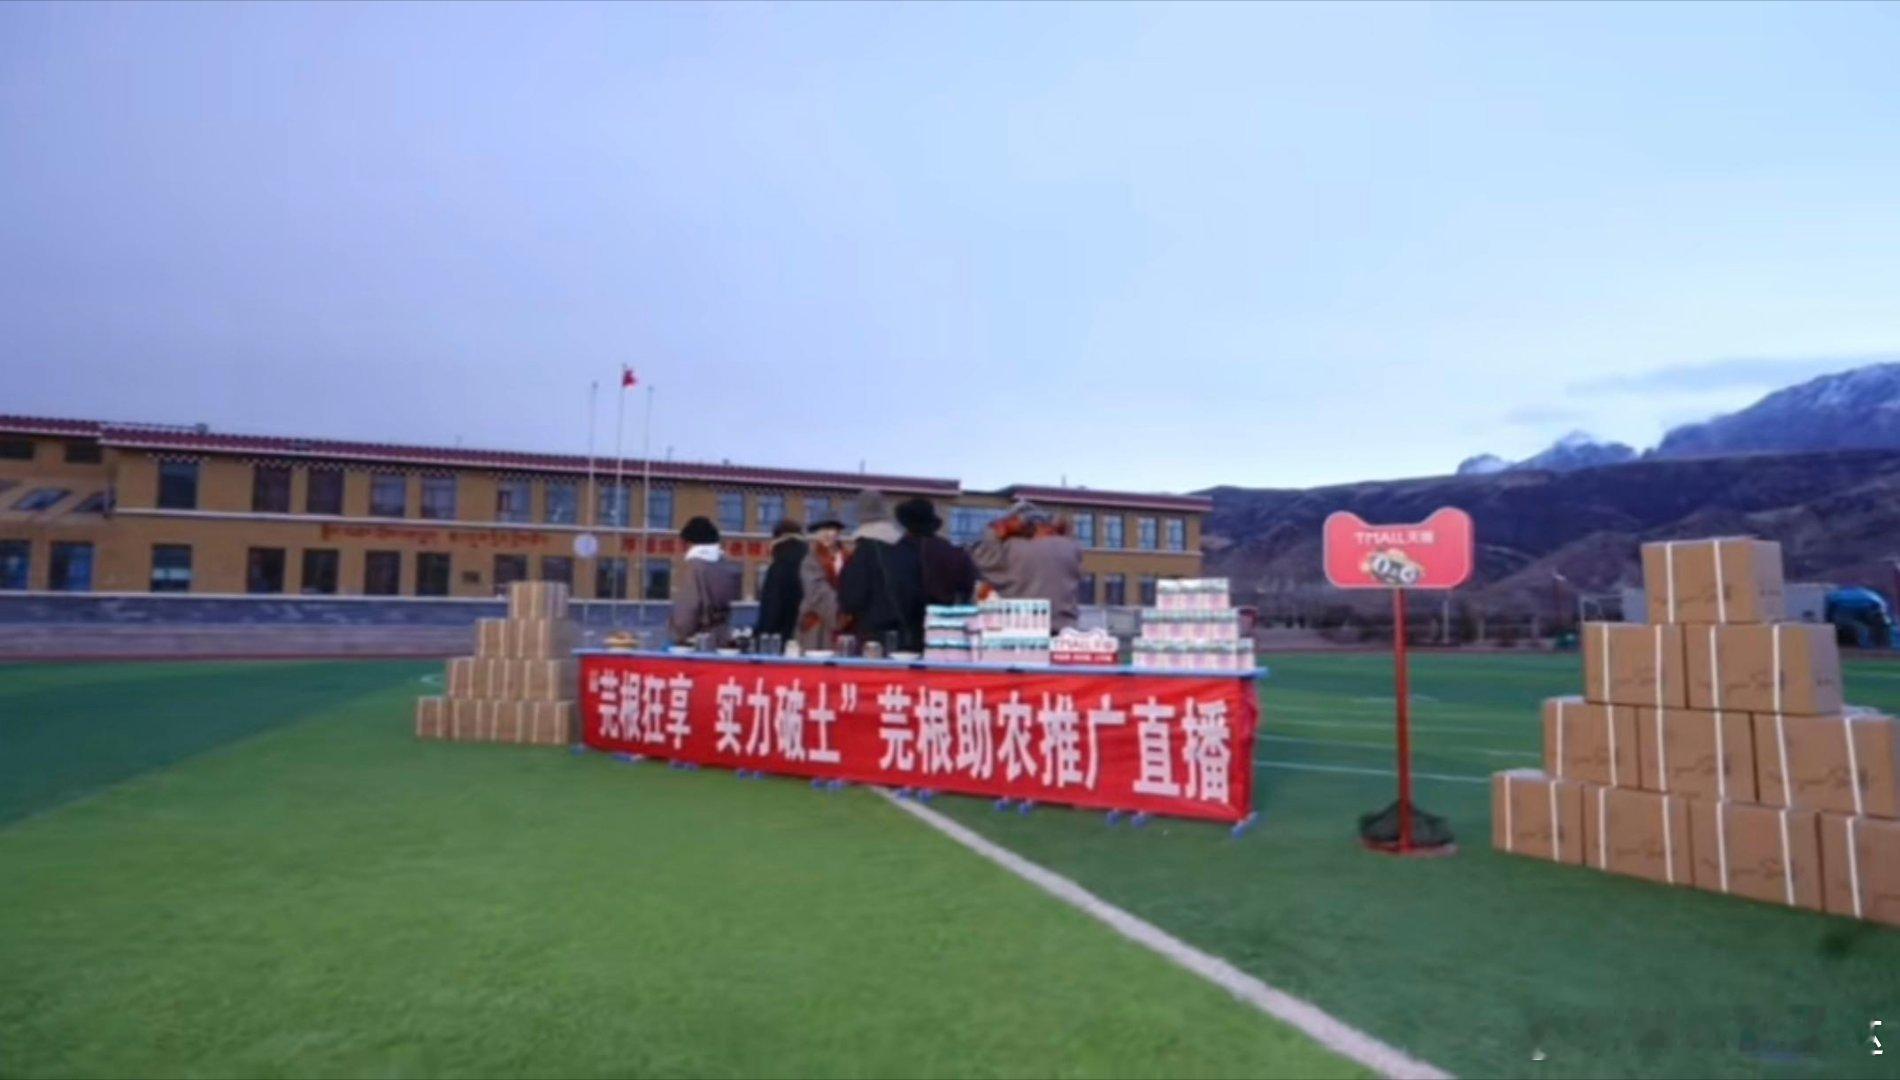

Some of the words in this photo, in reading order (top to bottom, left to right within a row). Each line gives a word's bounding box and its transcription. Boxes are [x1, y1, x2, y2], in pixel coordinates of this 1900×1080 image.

[877, 684, 1231, 804] 芜根助农推广直播
